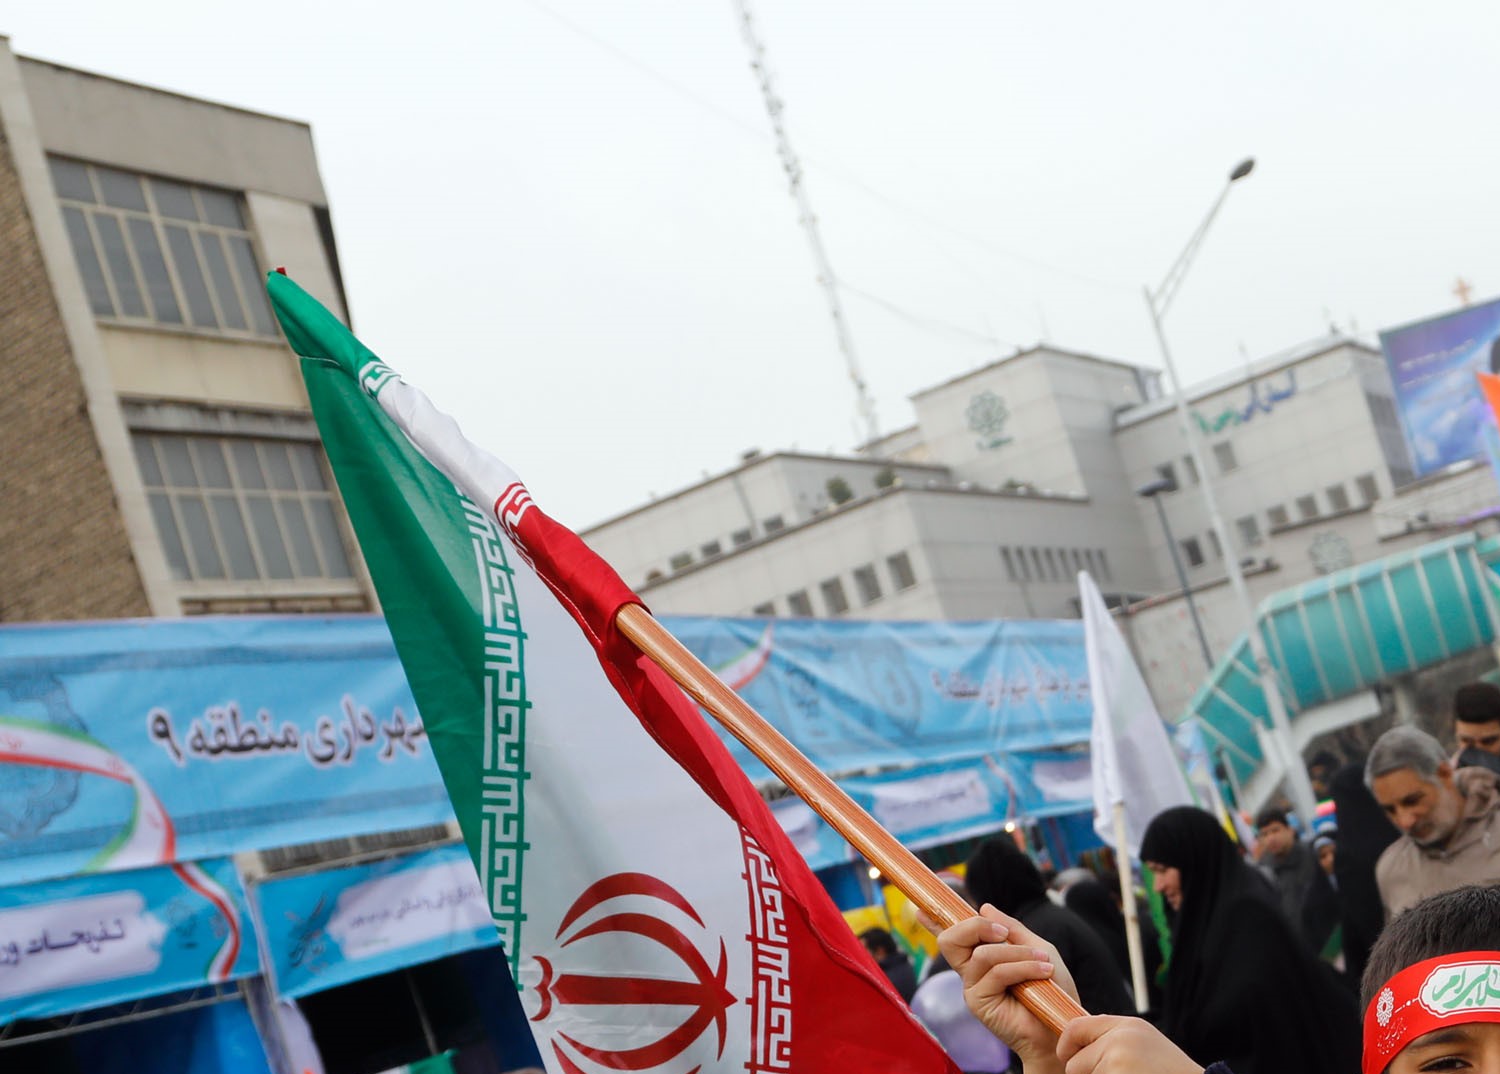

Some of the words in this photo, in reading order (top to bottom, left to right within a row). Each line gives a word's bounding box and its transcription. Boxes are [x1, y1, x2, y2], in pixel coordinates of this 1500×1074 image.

[151, 713, 182, 761] ۹
[188, 704, 299, 754] منطقه
[305, 697, 427, 764] هرداری
